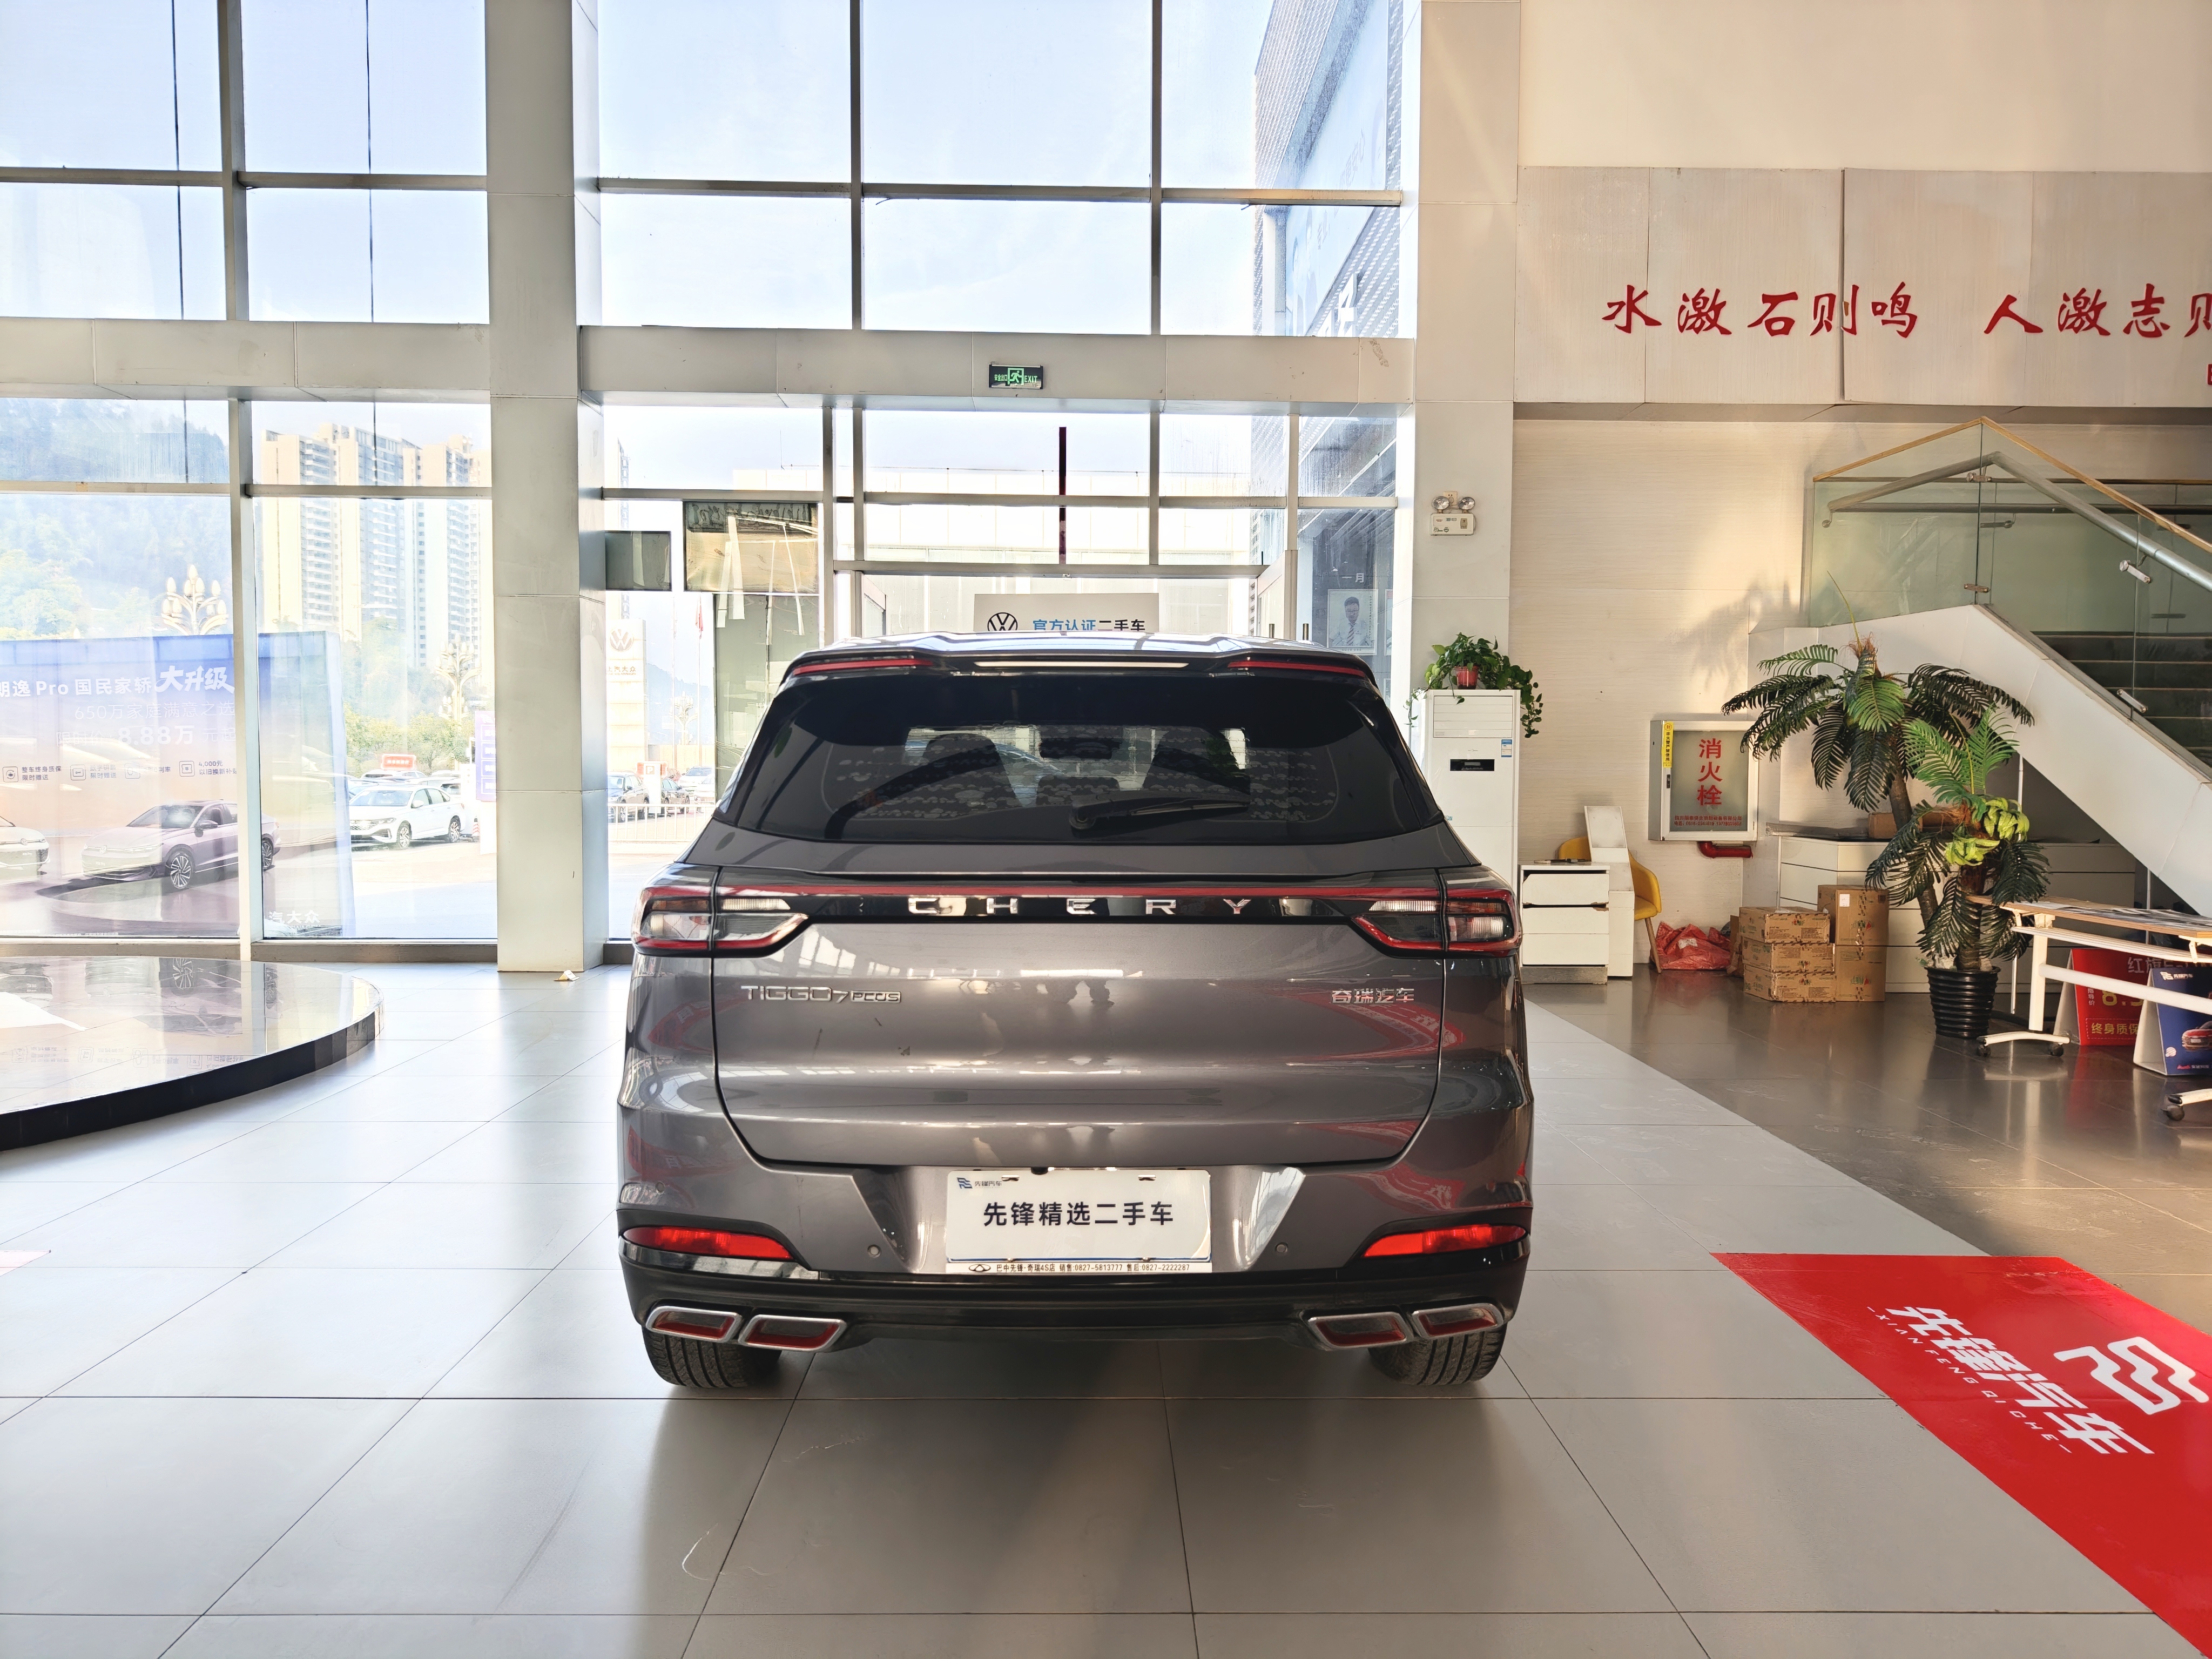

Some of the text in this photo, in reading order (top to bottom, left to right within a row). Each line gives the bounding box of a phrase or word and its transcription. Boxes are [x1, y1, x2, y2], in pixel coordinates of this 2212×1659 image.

[1602, 281, 1918, 338] 水激石则鸣
[1033, 619, 1145, 631] 官方认证二手车
[36, 680, 69, 696] Pro
[75, 677, 152, 695] 国民家轿
[154, 665, 235, 694] 大升级
[75, 700, 235, 719] 650万家庭满意之选
[1697, 738, 1723, 806] 消火栓
[908, 897, 1252, 915] CHERY
[1332, 988, 1414, 1003] 奇瑞汽车
[983, 1201, 1174, 1226] 先锋精选二手车
